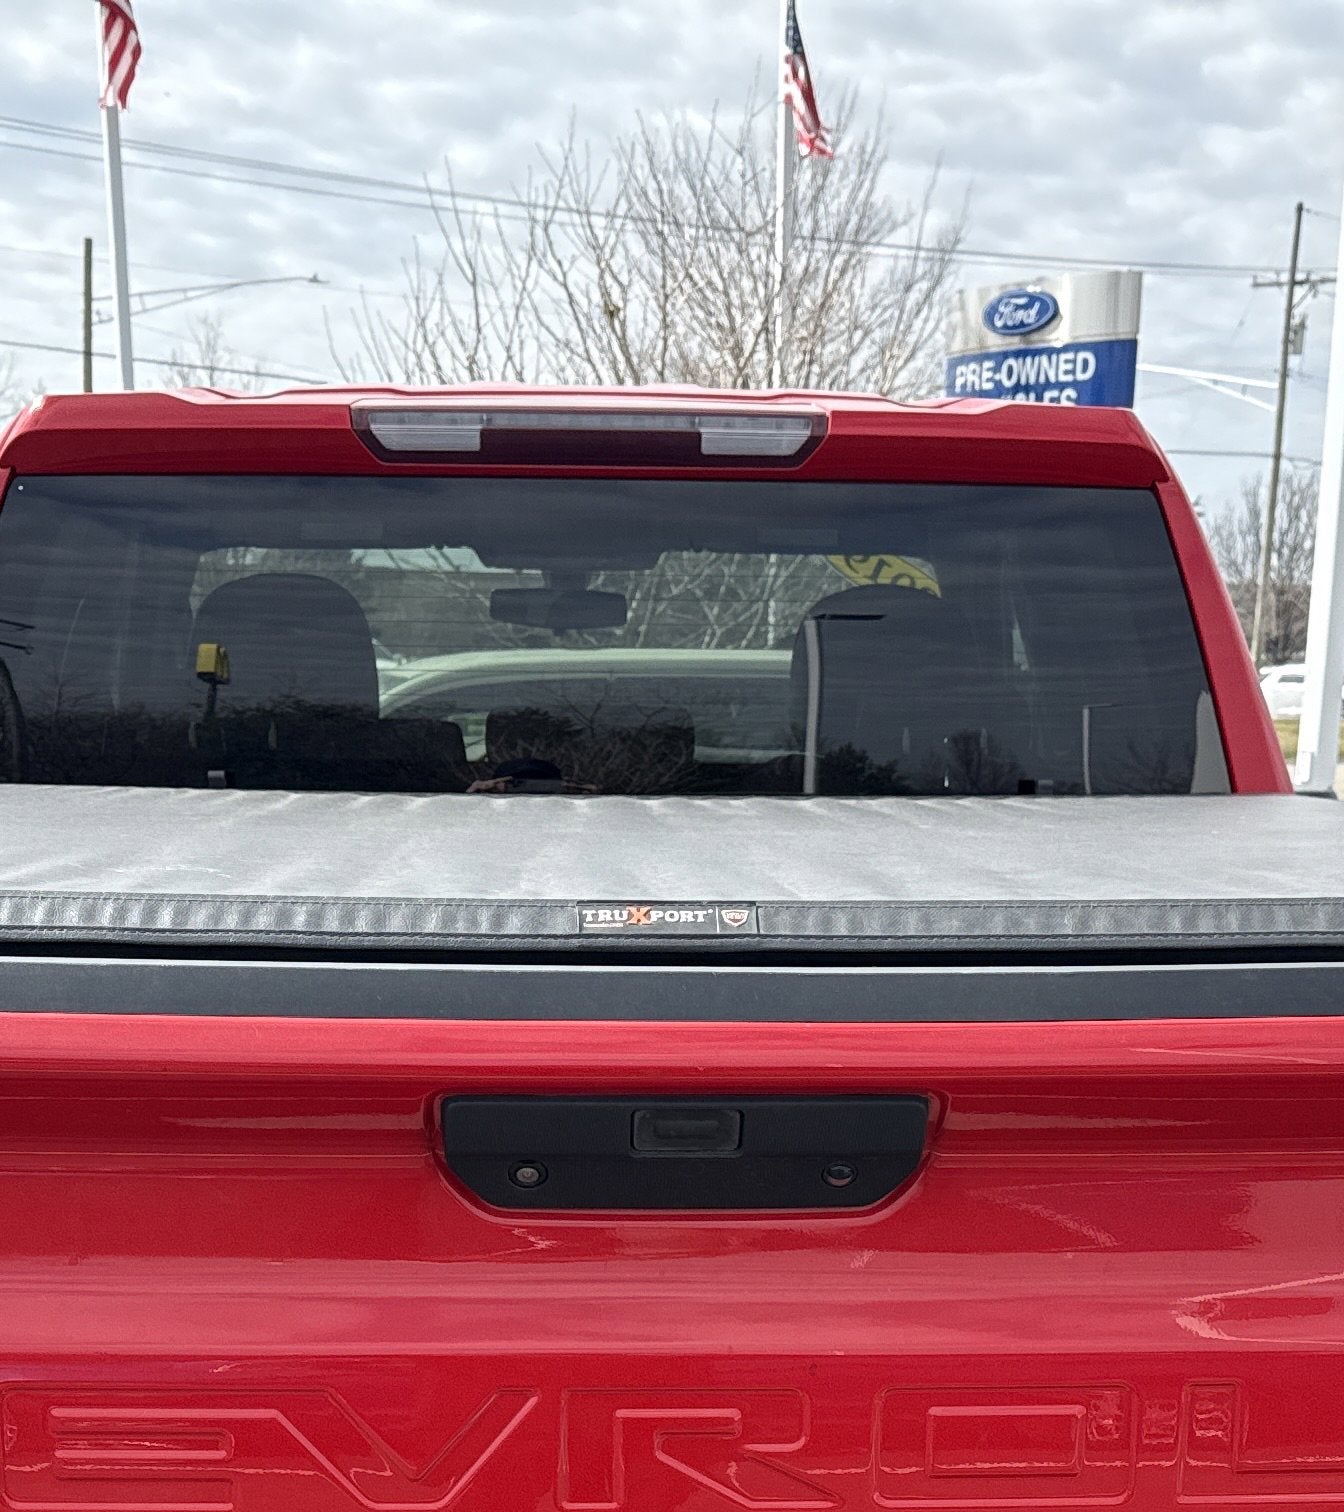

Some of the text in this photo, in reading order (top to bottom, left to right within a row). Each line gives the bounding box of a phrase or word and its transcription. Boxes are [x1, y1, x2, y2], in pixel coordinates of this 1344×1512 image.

[993, 296, 1041, 328] Ford
[954, 352, 1096, 393] PRE-OWNED
[582, 905, 709, 926] TRUXPORT
